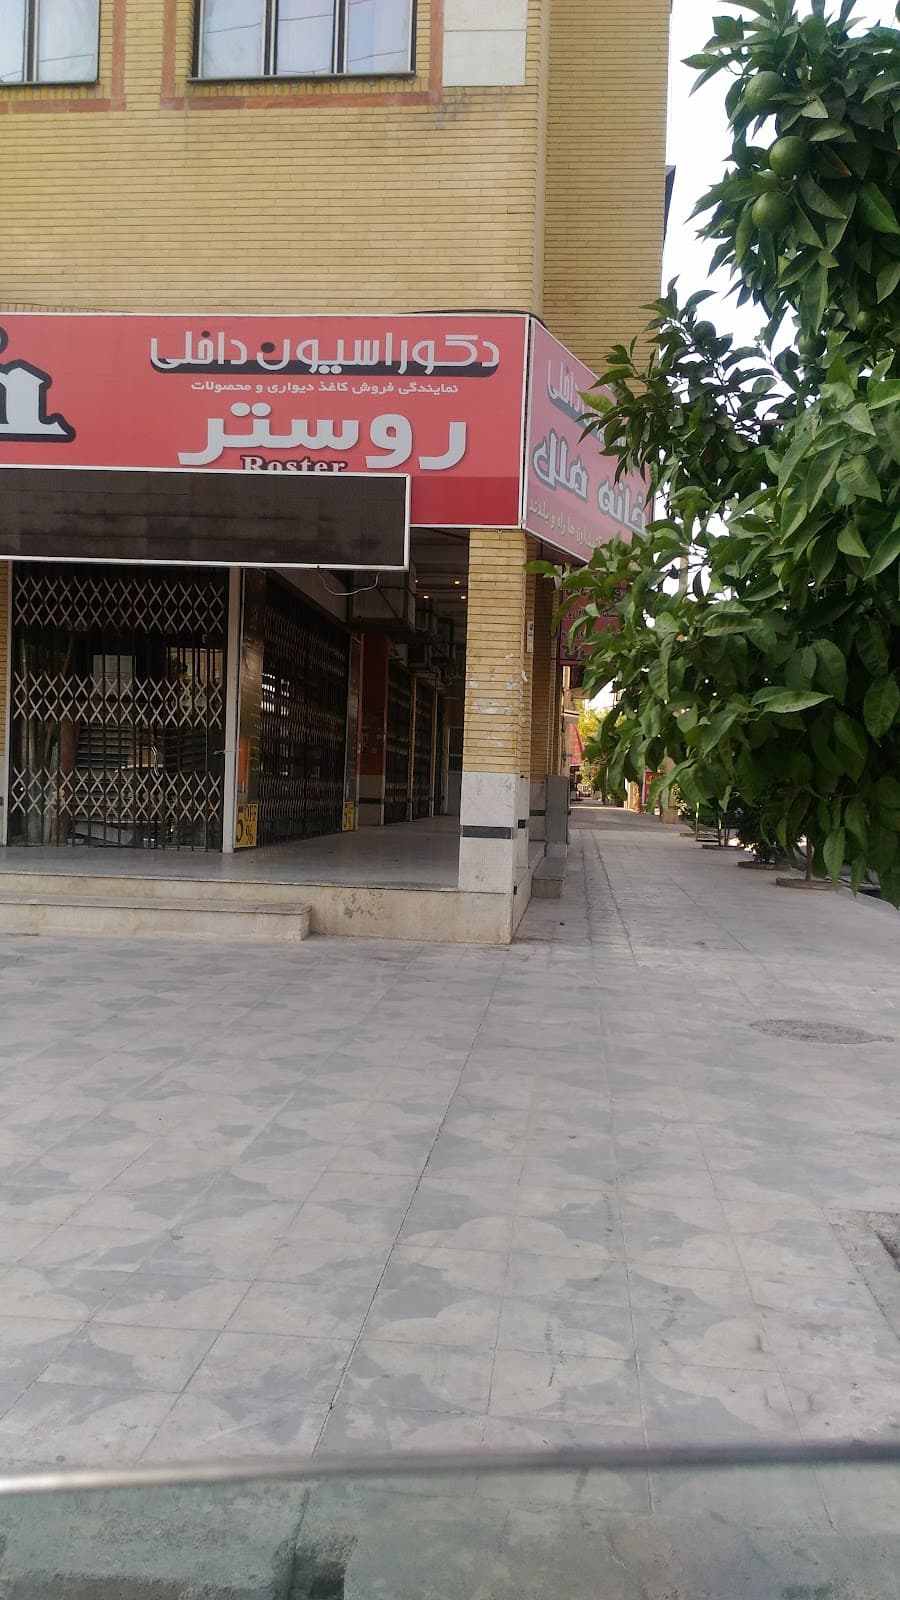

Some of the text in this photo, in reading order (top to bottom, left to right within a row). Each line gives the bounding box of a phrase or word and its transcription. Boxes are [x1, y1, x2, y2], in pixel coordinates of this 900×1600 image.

[150, 330, 500, 374] دکوراسیون داخلی
[191, 381, 459, 395] نمایندگی فروش کاغذ دیواری و محصولات
[178, 402, 467, 470] روستر
[240, 455, 347, 473] Roster
[598, 479, 649, 537] خانه
[244, 805, 257, 821] OFF
